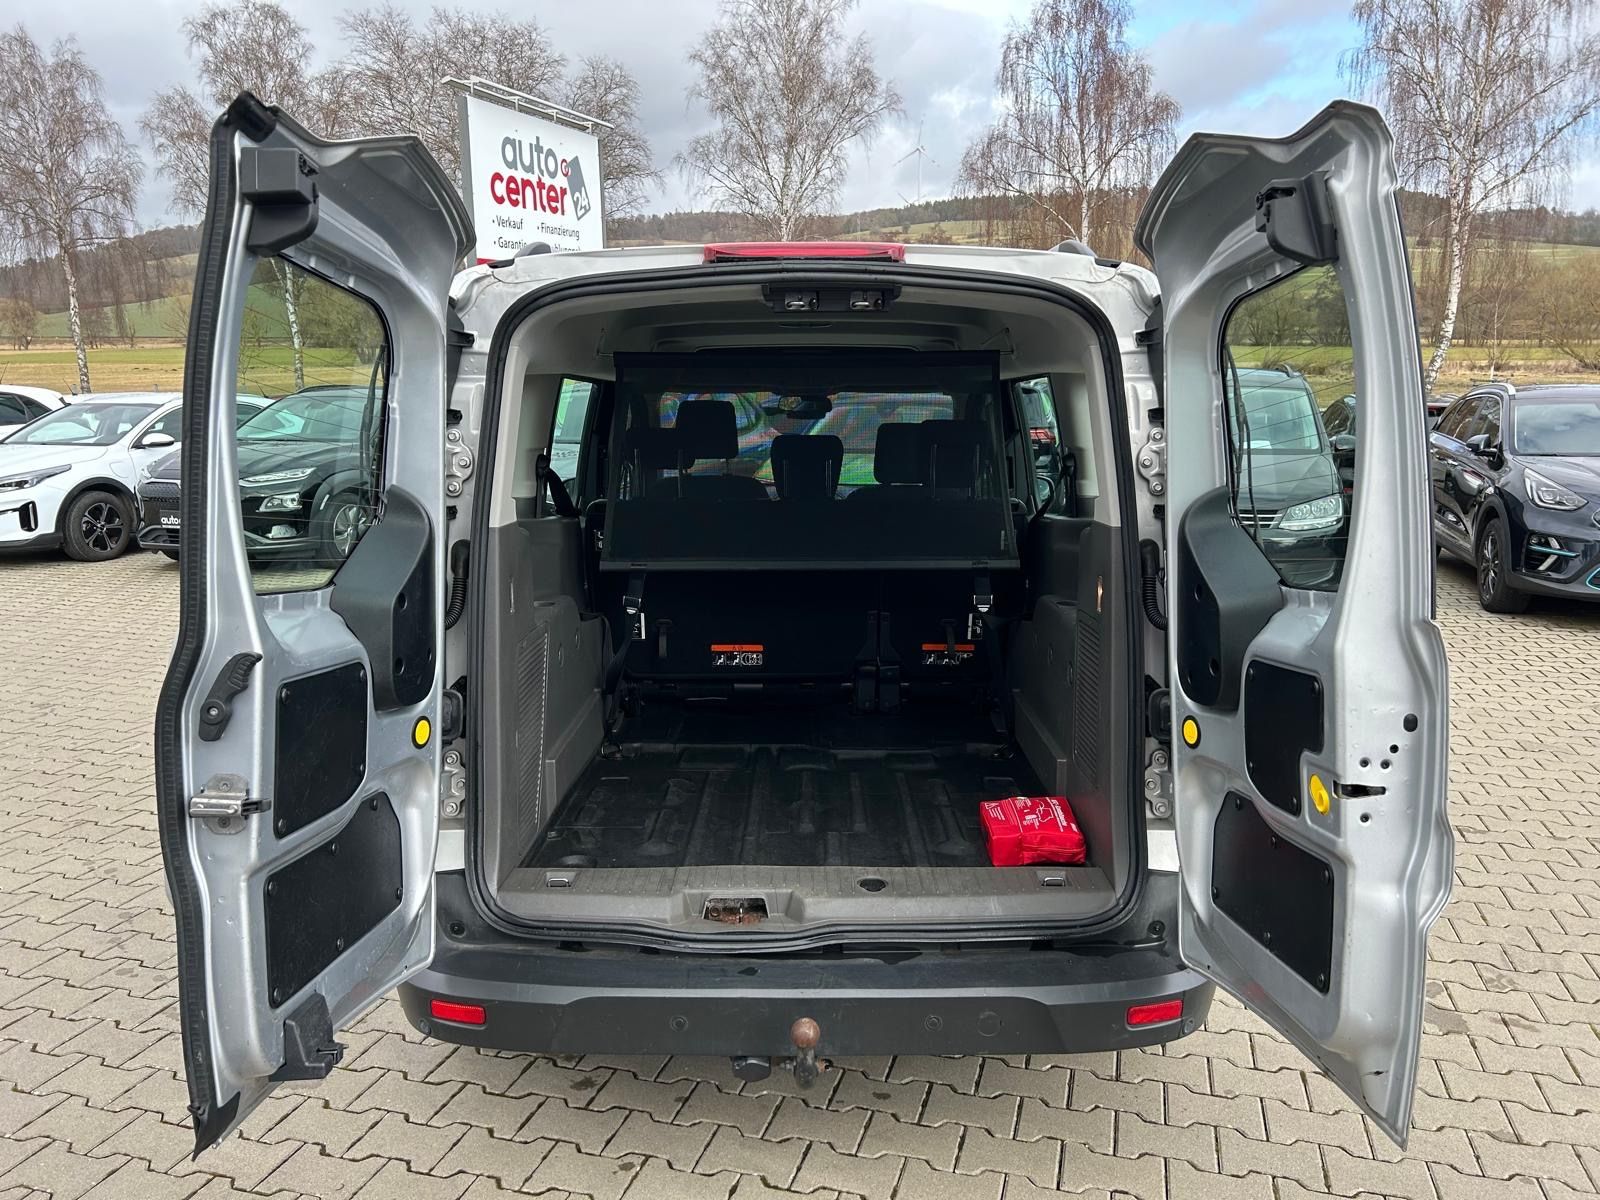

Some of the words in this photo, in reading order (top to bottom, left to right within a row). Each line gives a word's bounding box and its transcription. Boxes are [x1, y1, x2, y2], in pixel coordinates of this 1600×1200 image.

[501, 135, 559, 179] auto
[490, 171, 568, 216] center
[573, 186, 590, 217] 24
[496, 214, 524, 231] Verkauf
[540, 222, 580, 241] Finanzierung
